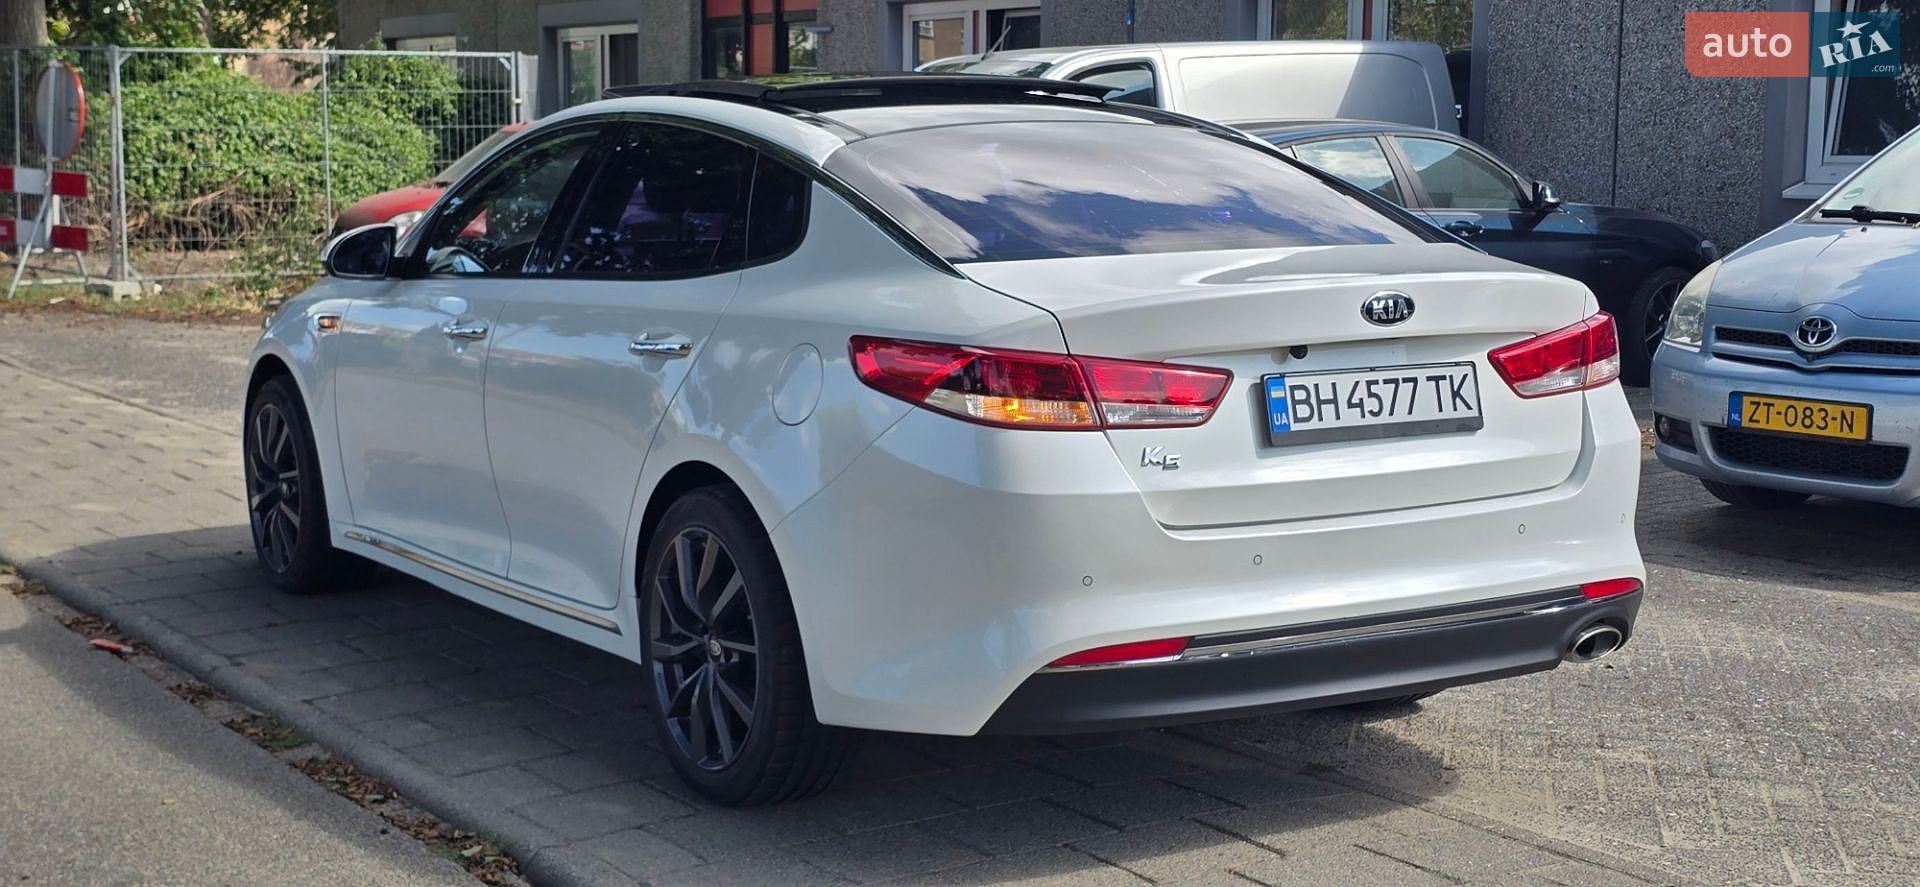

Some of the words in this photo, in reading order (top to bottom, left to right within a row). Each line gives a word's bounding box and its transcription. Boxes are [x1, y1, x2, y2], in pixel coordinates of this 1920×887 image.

[1372, 299, 1408, 319] KIA
[1289, 382, 1341, 424] BH
[1347, 376, 1419, 419] 4577
[1426, 373, 1473, 413] TK
[1273, 412, 1289, 425] UA
[1748, 401, 1854, 433] ZT-083-N
